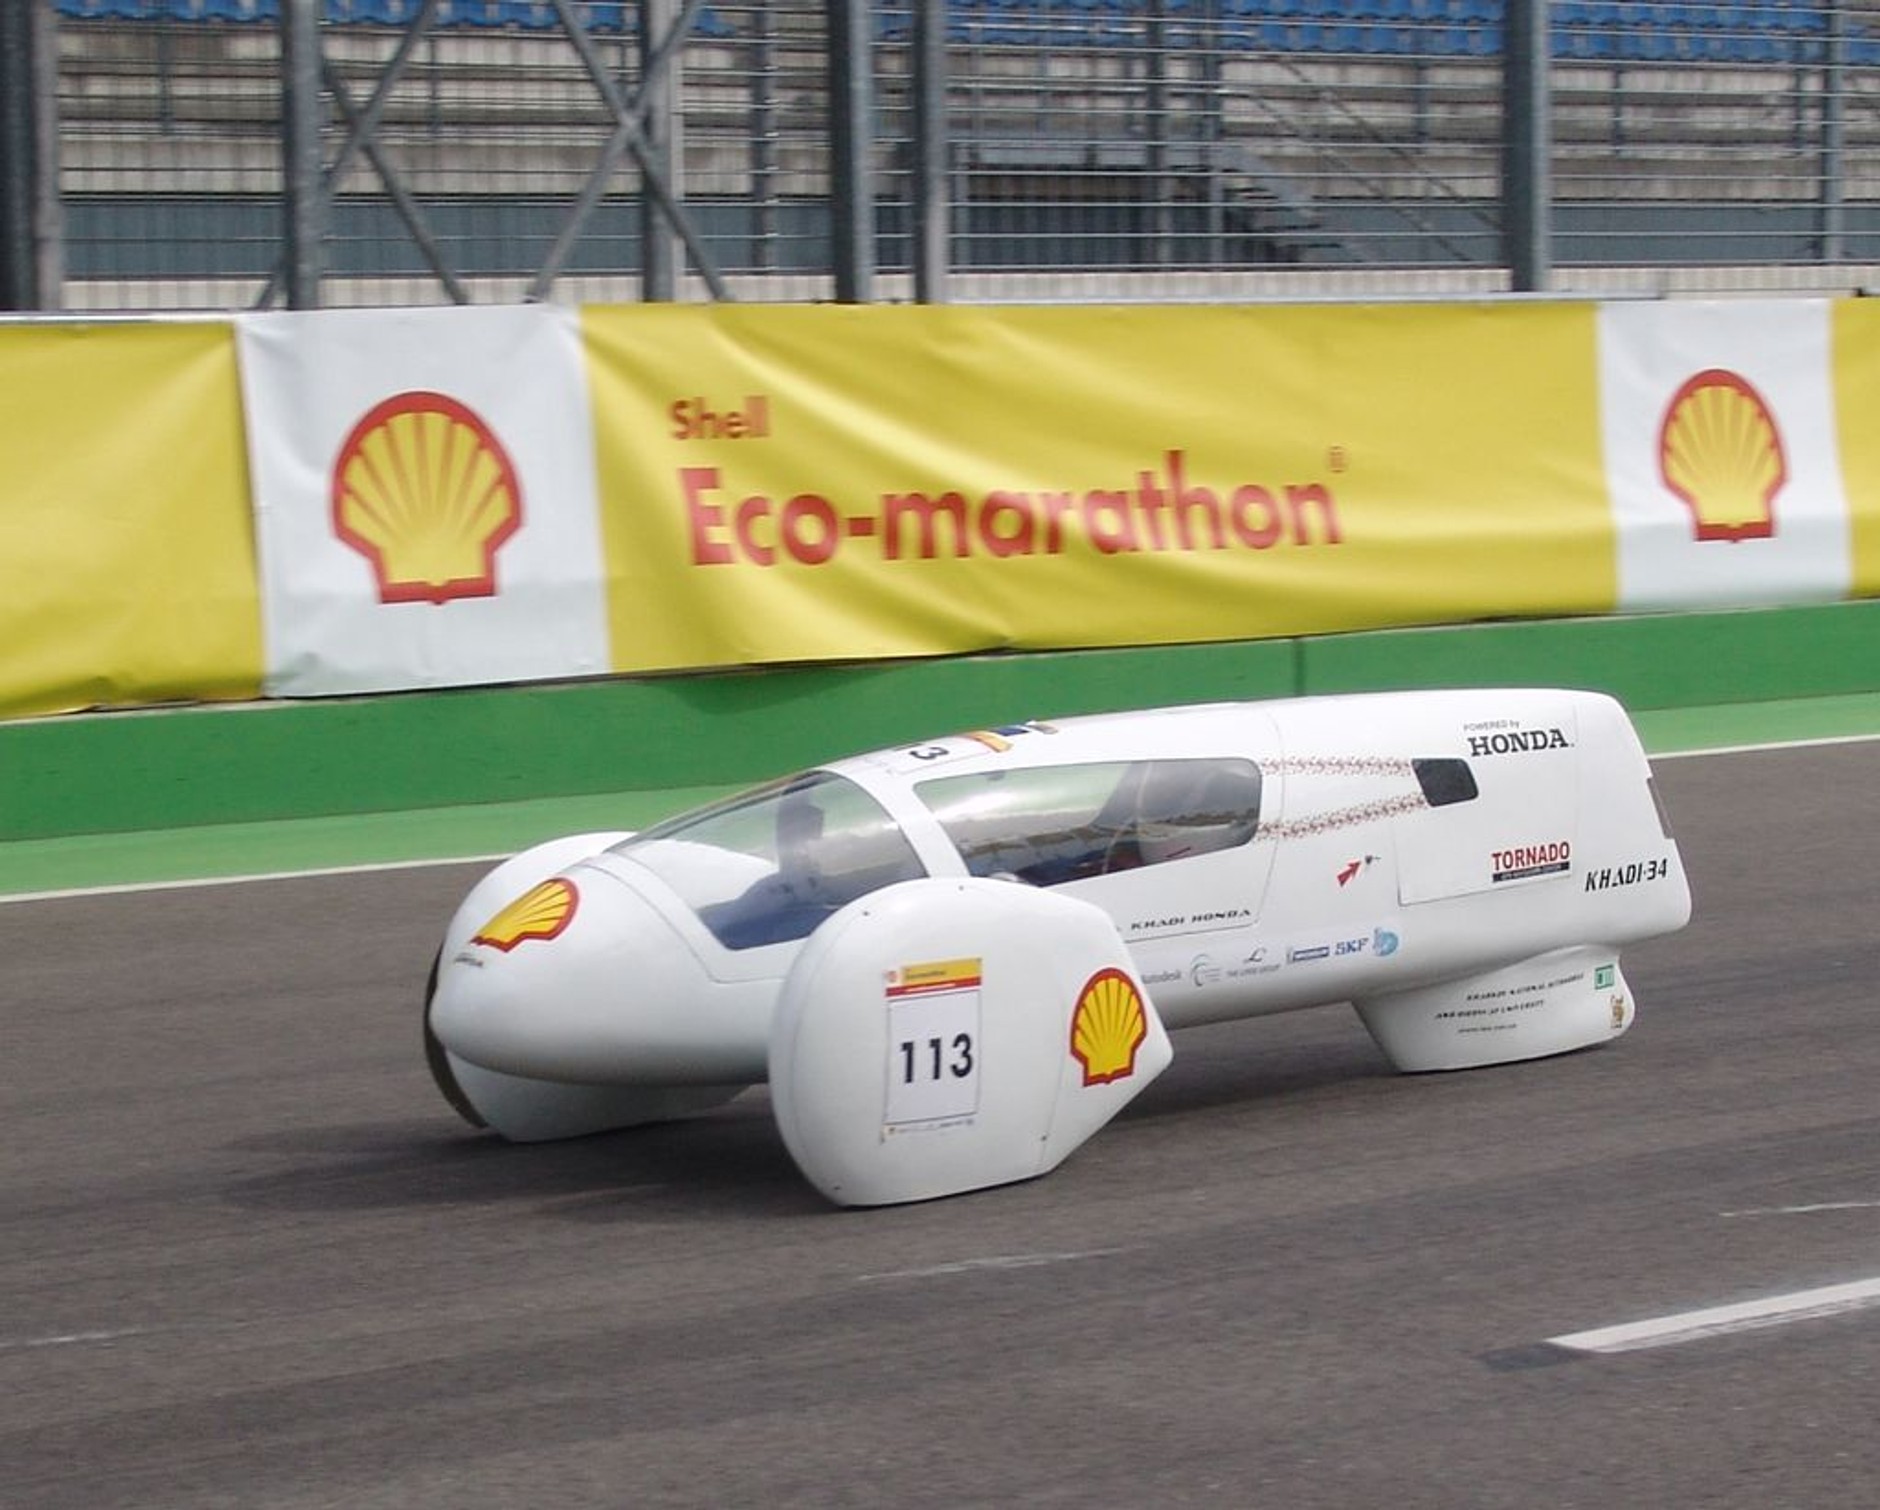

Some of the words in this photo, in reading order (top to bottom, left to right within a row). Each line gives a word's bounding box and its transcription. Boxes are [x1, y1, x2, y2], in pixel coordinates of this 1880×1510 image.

[670, 395, 770, 439] Shell
[679, 449, 1343, 566] Eco-marathon
[1467, 728, 1570, 757] HONDA
[1491, 841, 1570, 871] TORNADO
[1131, 917, 1185, 930] KHADI
[1191, 909, 1251, 923] HONDA
[1334, 938, 1370, 956] SKF
[901, 1033, 973, 1083] 113
